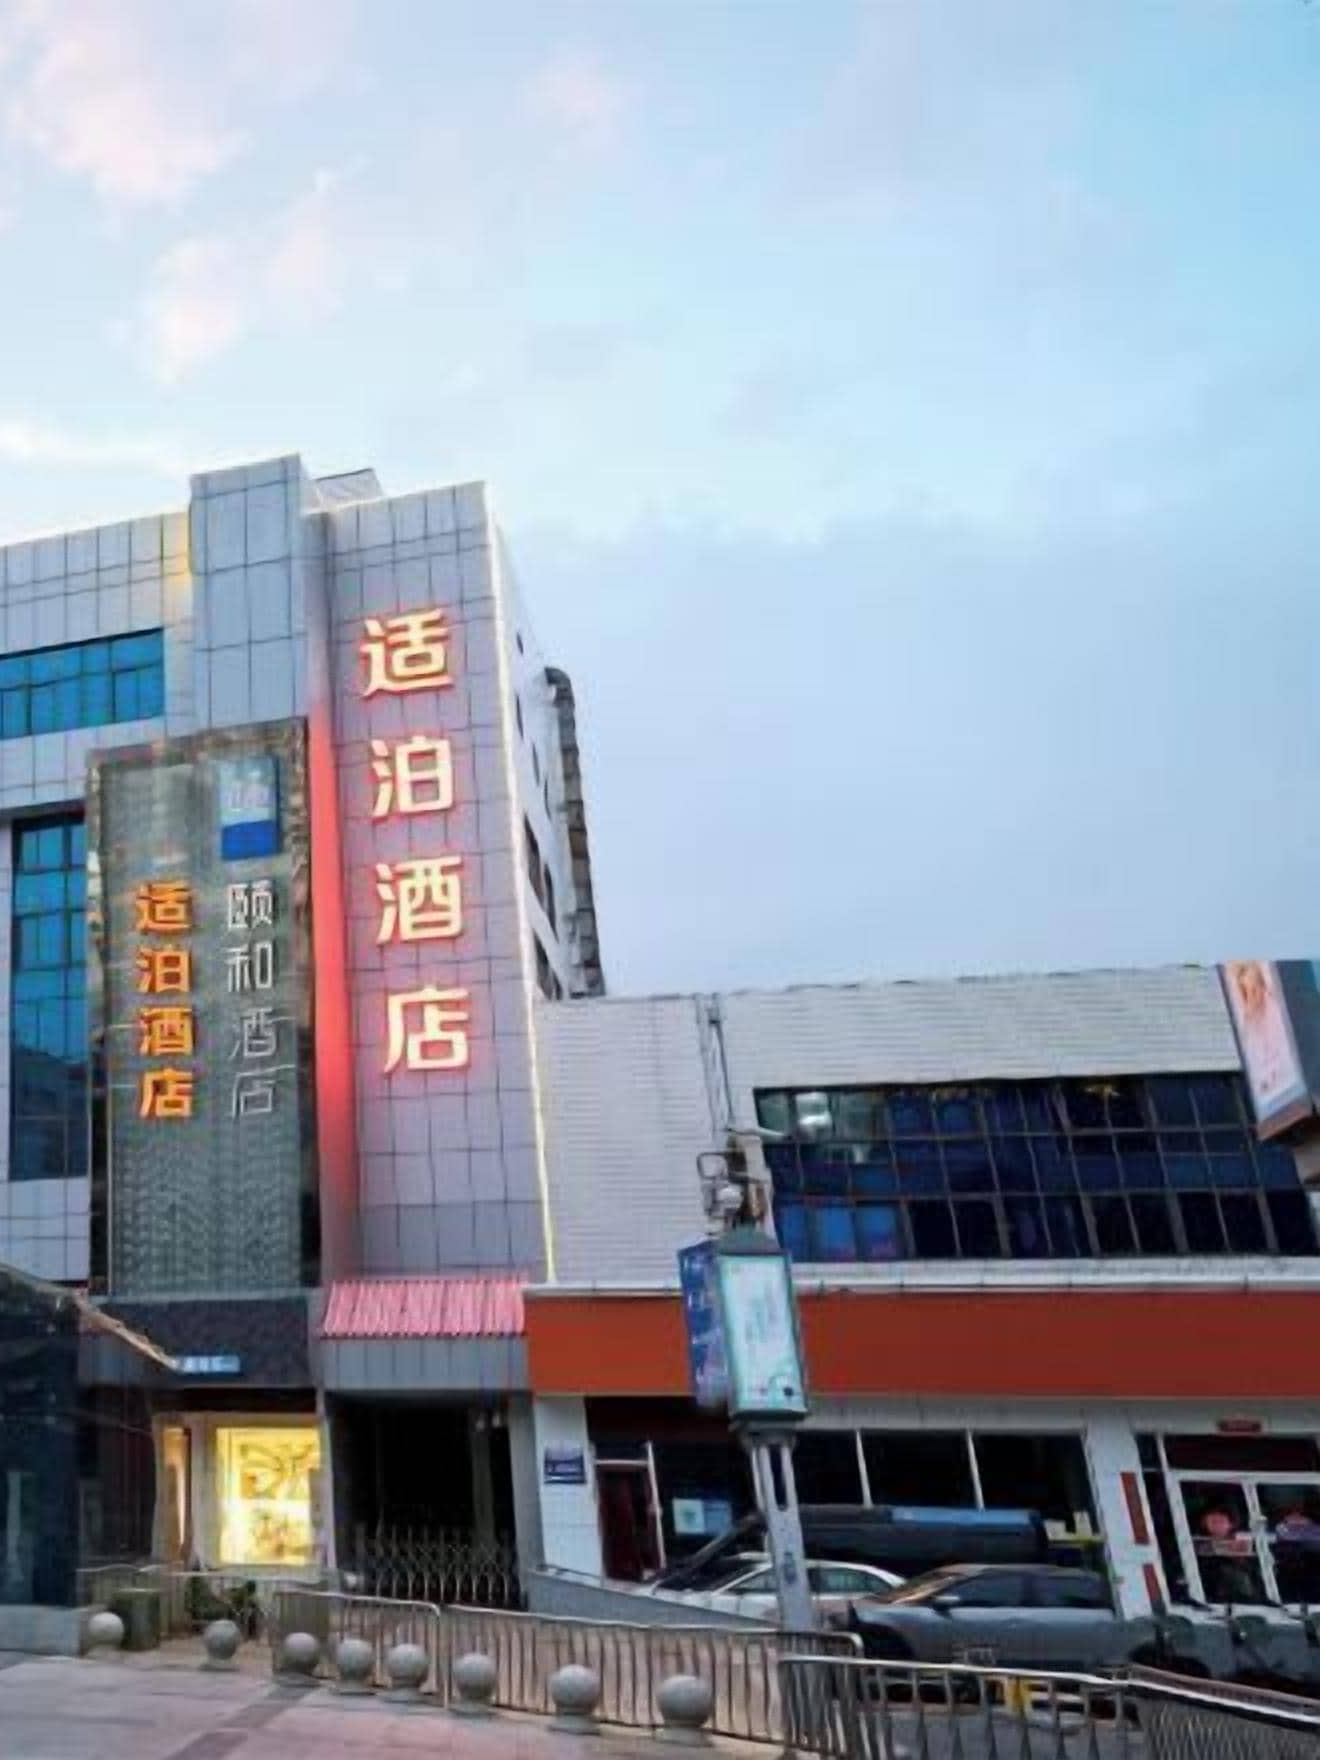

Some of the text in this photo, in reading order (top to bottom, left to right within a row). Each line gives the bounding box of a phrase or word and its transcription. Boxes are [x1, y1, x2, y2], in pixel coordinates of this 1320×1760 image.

[359, 607, 470, 1074] 适泊酒店
[135, 880, 195, 1119] 适泊酒店
[224, 879, 280, 1119] 颐和酒店
